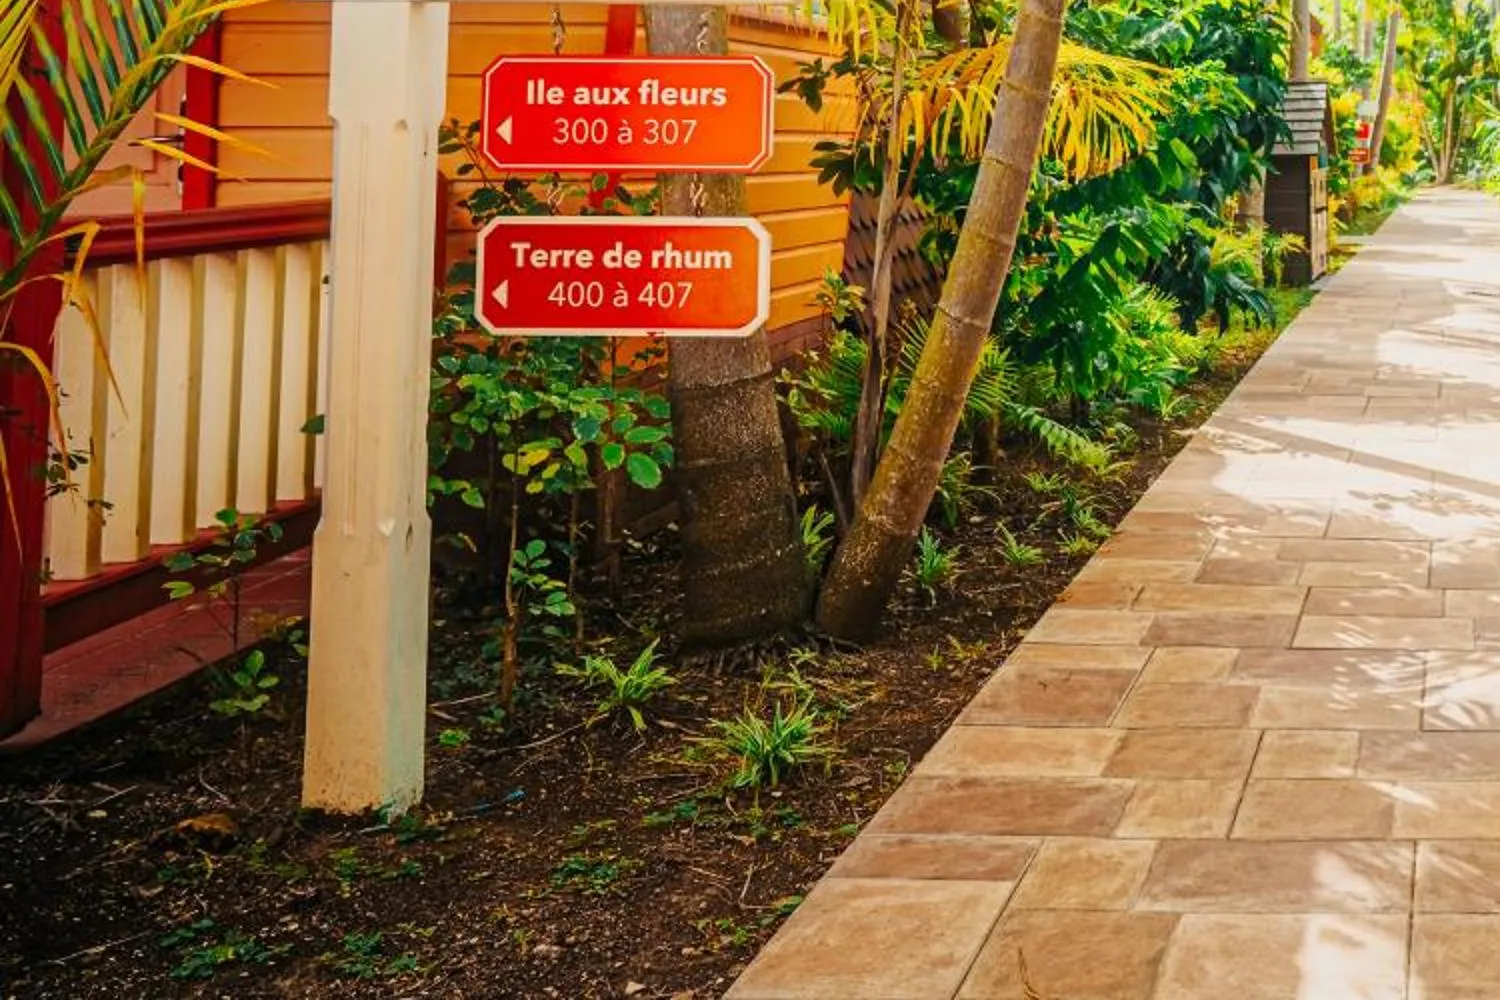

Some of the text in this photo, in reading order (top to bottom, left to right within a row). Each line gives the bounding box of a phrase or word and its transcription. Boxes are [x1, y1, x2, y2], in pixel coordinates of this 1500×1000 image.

[527, 78, 727, 106] Ile aux fleurs
[552, 117, 697, 145] 300 à 307
[510, 241, 733, 270] Terre de rhum
[547, 281, 693, 308] 400 à 407
